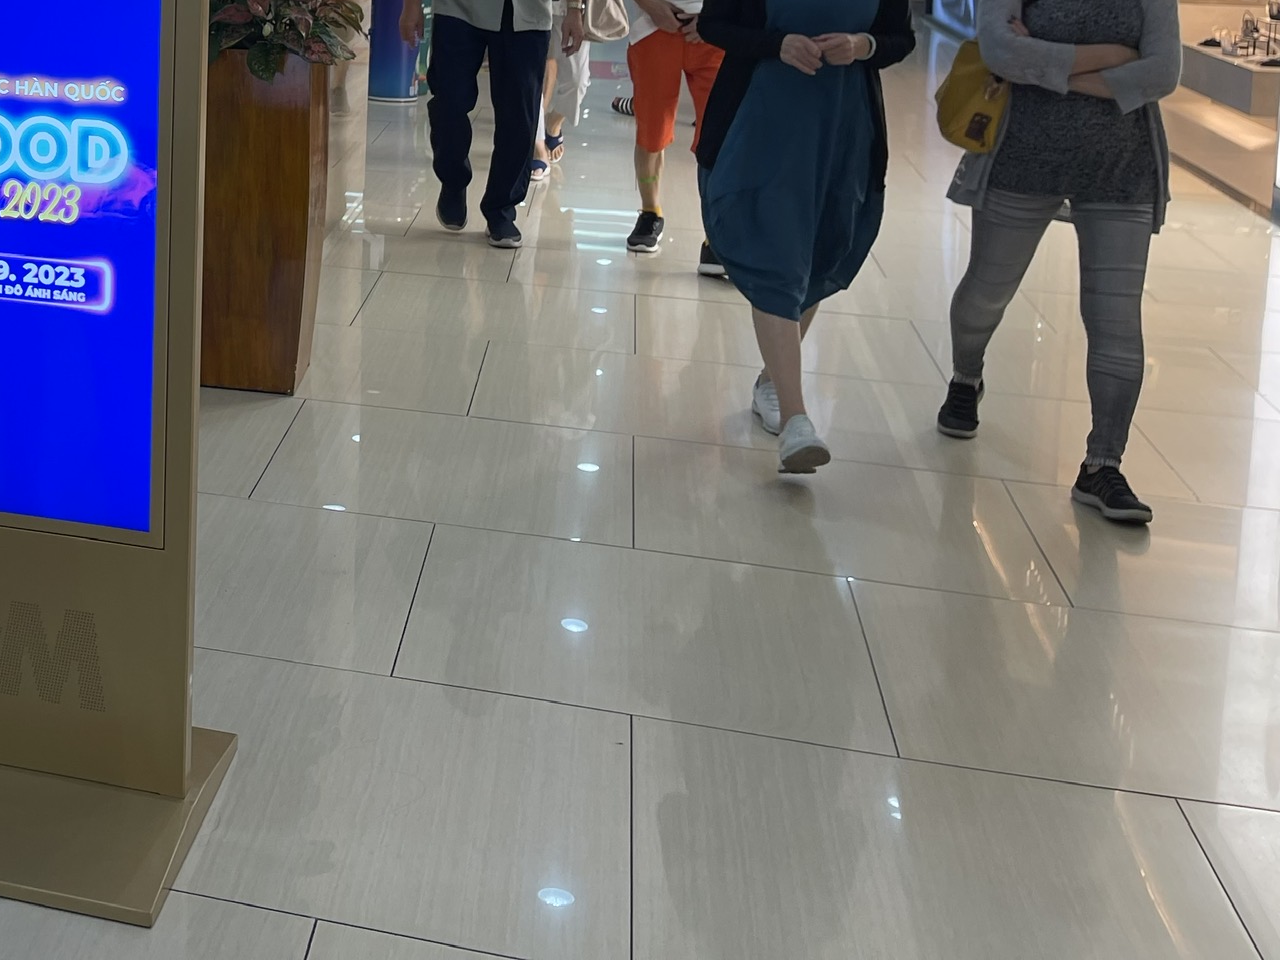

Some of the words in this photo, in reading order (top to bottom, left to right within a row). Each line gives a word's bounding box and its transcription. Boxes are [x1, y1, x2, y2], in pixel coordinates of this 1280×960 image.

[15, 77, 58, 98] HÀN
[64, 80, 125, 102] QUỐC
[0, 178, 82, 224] 2023
[22, 262, 85, 288] 2023
[4, 283, 23, 296] ĐÔ
[24, 285, 51, 299] ÁNH
[53, 288, 86, 302] SÁNG
